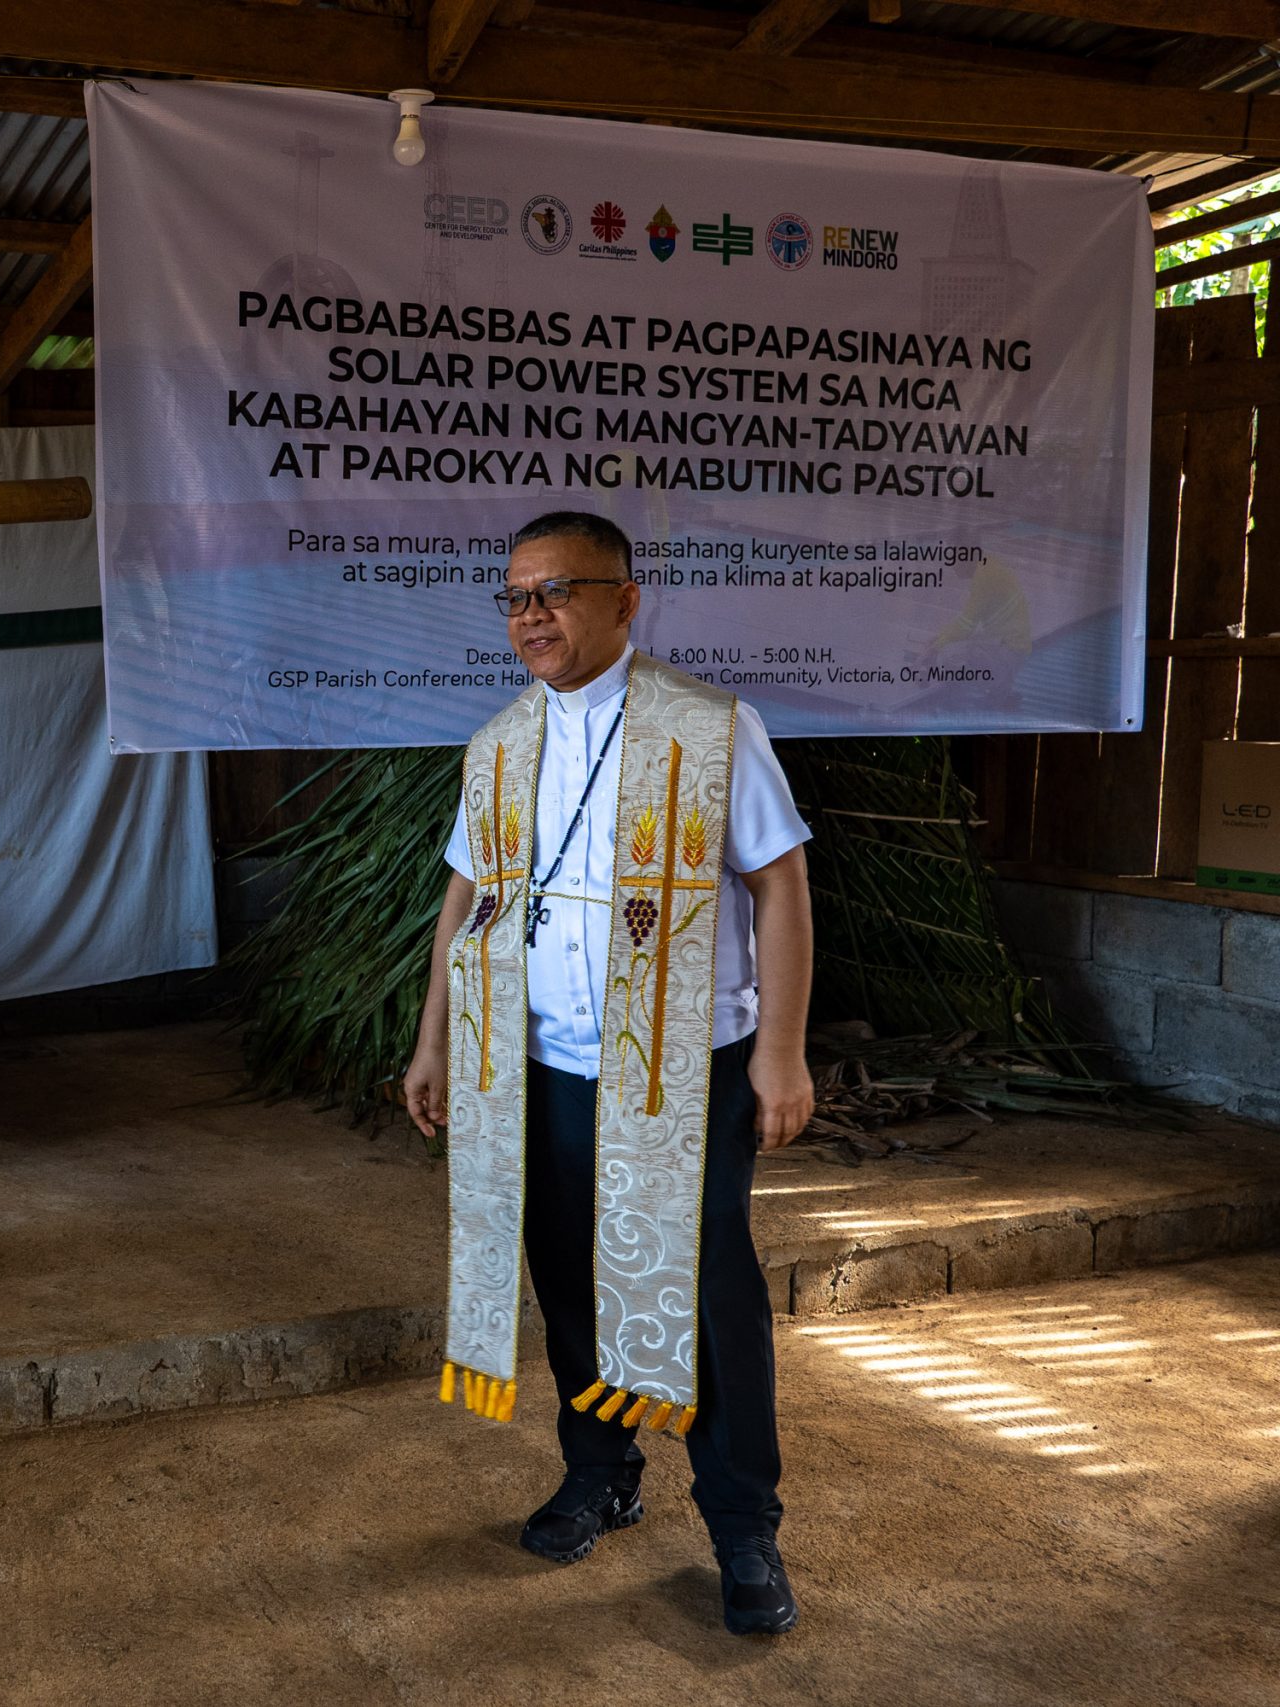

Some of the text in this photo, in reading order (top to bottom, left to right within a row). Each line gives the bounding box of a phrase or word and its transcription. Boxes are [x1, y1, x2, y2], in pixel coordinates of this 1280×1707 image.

[424, 194, 510, 226] CEED
[425, 222, 446, 231] CENTER
[453, 232, 493, 241] DEVELOPMENT
[823, 226, 899, 252] RENEW
[579, 243, 602, 254] Caritas
[603, 245, 638, 257] Philippines
[823, 248, 898, 270] MINDORO
[238, 291, 1032, 372] PAGBABASBAS AT PAGPAPASINAYA NG
[328, 346, 961, 412] SOLAR POWER SYSTEM SA MGA
[228, 390, 1028, 456] KABAHAYAN NG MANGYAN-TADYAWAN
[269, 442, 994, 498] AT PAROKYA NG MABUTING PASTOL
[288, 529, 345, 552] Para
[353, 535, 380, 553] sa
[388, 535, 460, 557] mura,
[634, 537, 744, 562] aasahang
[752, 538, 849, 565] kuryente
[854, 543, 877, 561] sa
[883, 540, 988, 567] lalawigan,
[342, 561, 367, 582] at
[374, 562, 465, 588] sagipin
[690, 569, 718, 586] na
[725, 565, 785, 587] klima
[792, 567, 813, 587] at
[819, 566, 944, 592] kapaligiran!
[669, 648, 707, 665] 8:00
[713, 648, 745, 664] N.U.
[763, 648, 799, 664] 5:00
[804, 648, 836, 664] N.H.
[268, 670, 309, 688] GSP
[315, 670, 377, 688] Parish
[383, 670, 496, 688] Conference
[720, 668, 822, 688] Community,
[827, 667, 894, 685] Victoria,
[900, 667, 923, 683] Or.
[928, 665, 995, 682] Mindoro.
